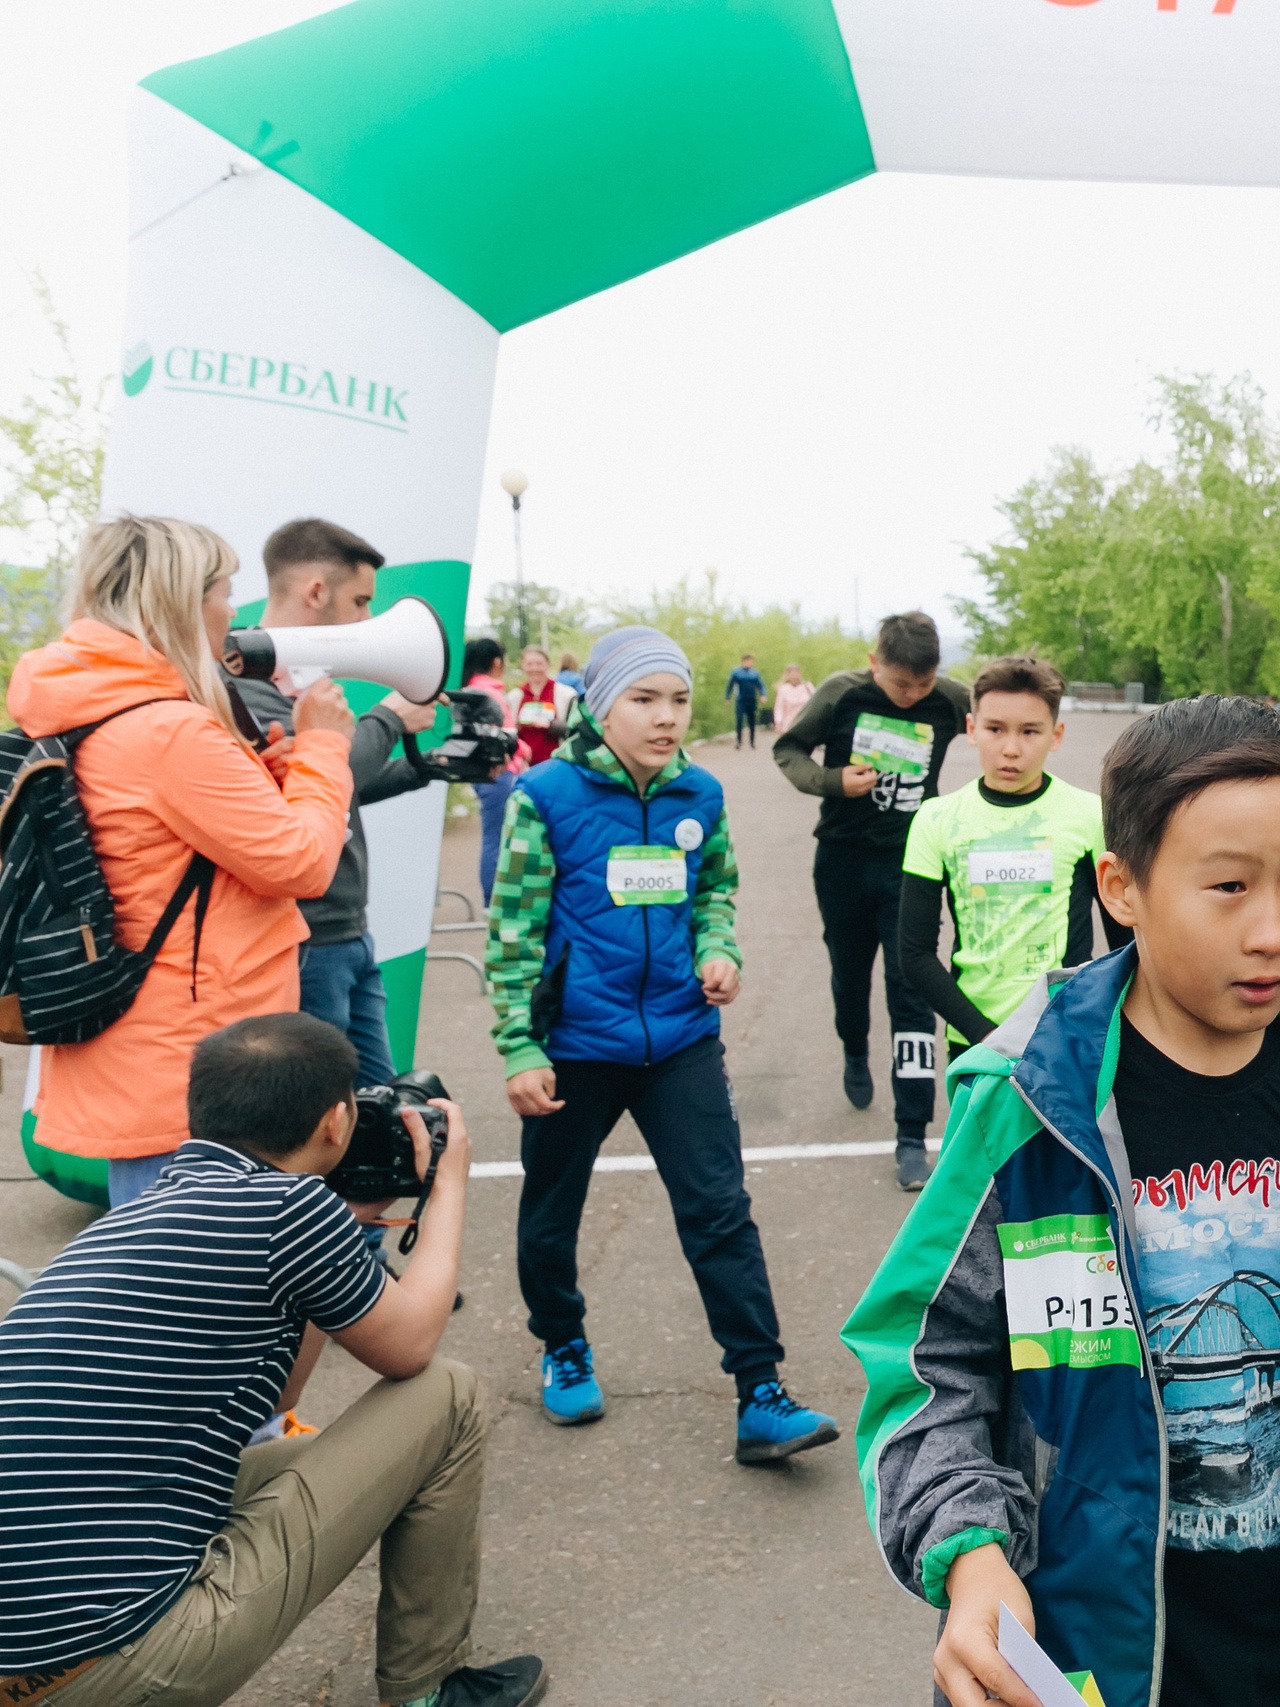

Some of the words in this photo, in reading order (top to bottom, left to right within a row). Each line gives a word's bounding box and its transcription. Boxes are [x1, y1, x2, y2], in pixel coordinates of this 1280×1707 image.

[164, 346, 408, 423] СБЕРБАНК
[985, 868, 1036, 881] P-0022
[624, 876, 674, 889] P-0005
[1025, 1233, 1067, 1249] СБЕРБАНК
